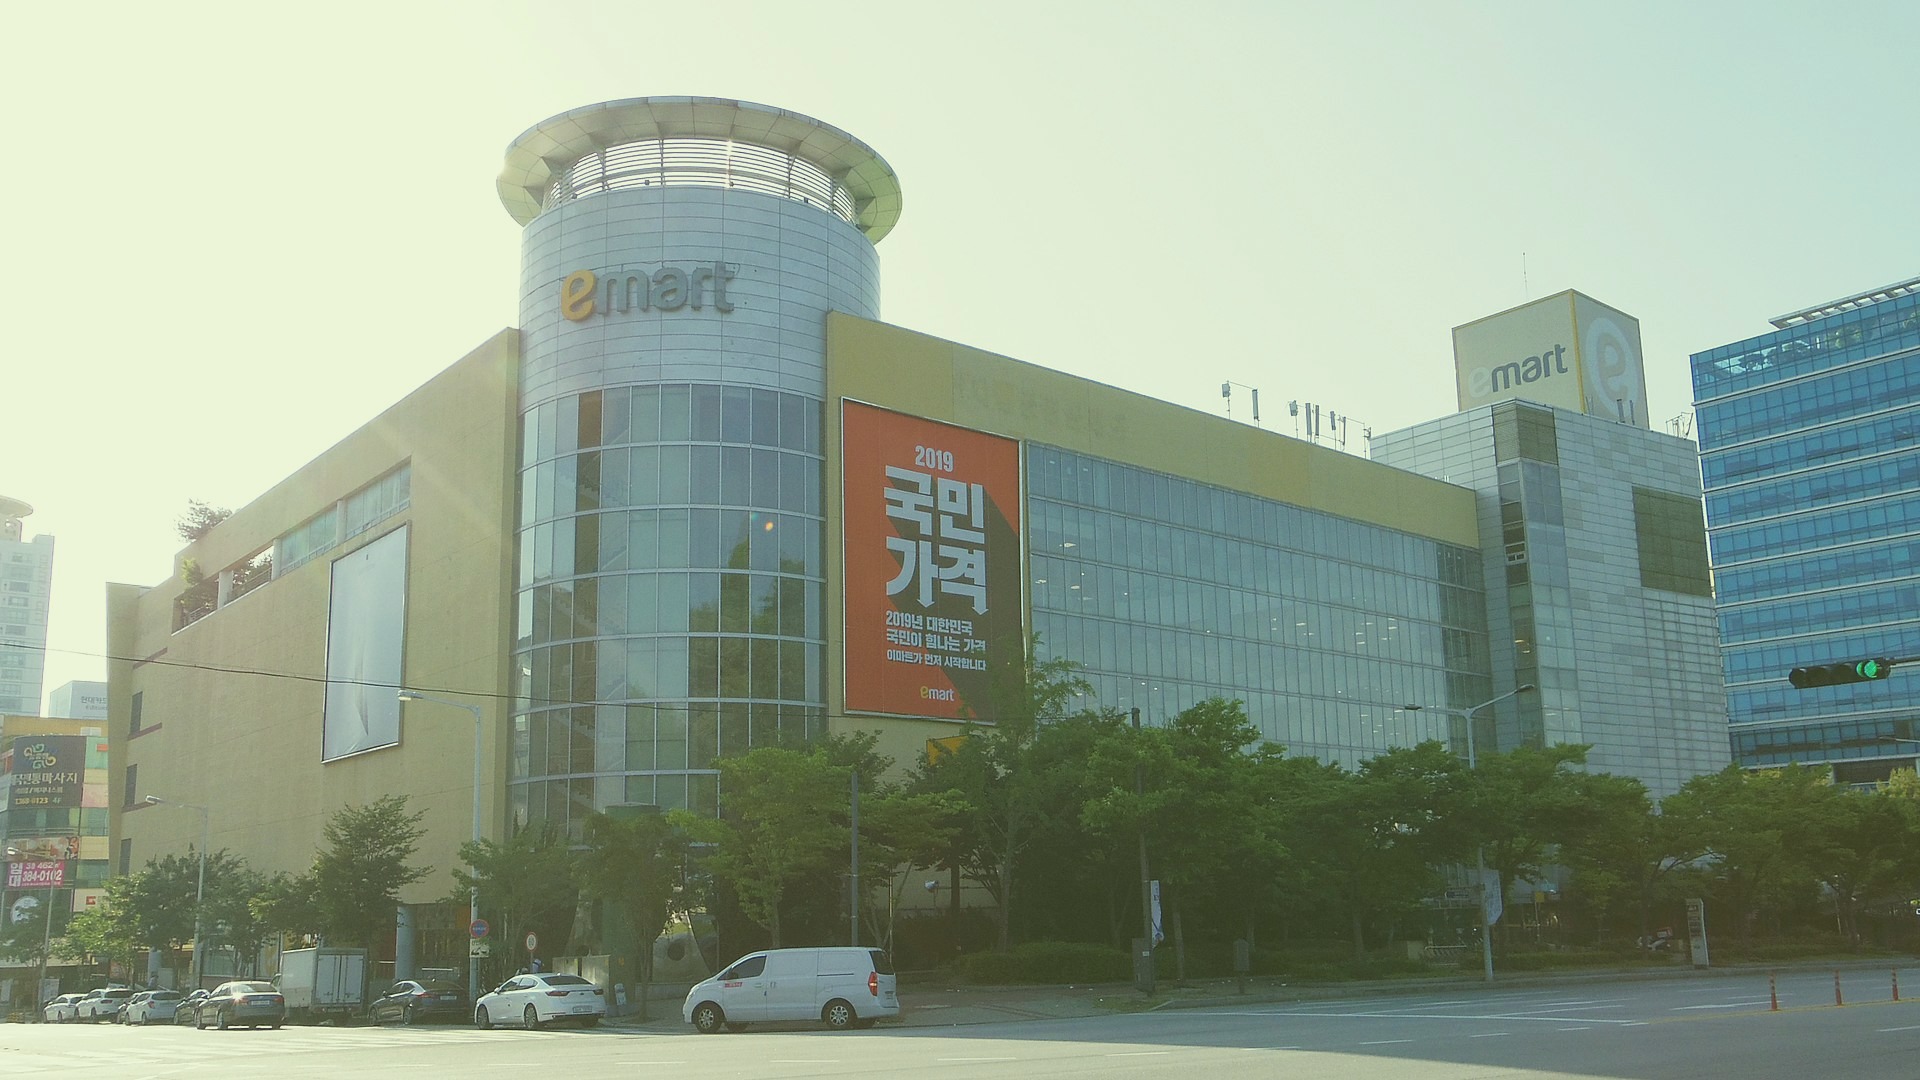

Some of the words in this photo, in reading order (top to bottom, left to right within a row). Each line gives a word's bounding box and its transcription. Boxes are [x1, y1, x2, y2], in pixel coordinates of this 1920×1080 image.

[561, 261, 735, 321] emart
[1468, 344, 1568, 398] emart
[915, 445, 954, 472] 2019
[884, 464, 986, 544] 국민
[886, 535, 989, 615] 가격
[885, 610, 923, 631] 2019년
[926, 616, 973, 636] 대한민국
[886, 628, 922, 647] 국민이
[925, 633, 961, 652] 힘나는
[963, 638, 986, 654] 가격
[886, 649, 923, 664] 이마트가
[924, 653, 942, 666] 먼저
[944, 656, 986, 671] 시작합니다
[920, 686, 955, 702] emart
